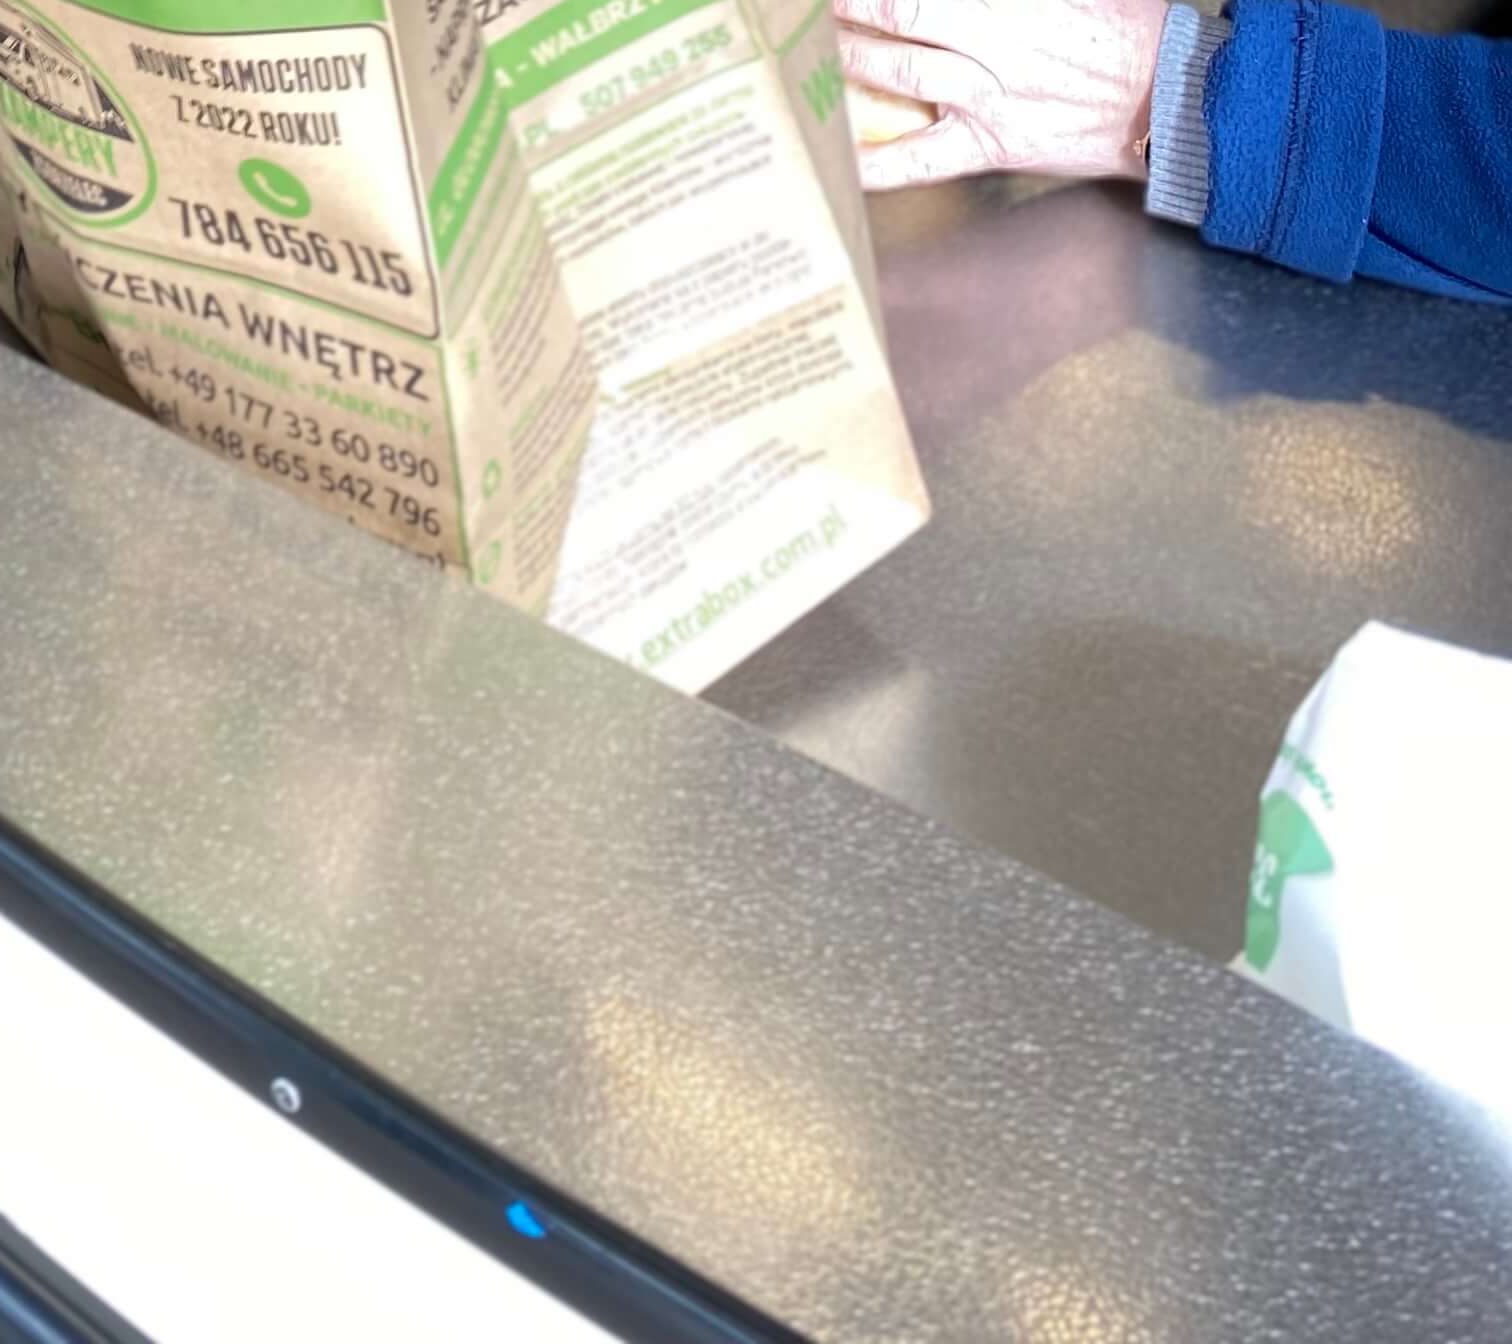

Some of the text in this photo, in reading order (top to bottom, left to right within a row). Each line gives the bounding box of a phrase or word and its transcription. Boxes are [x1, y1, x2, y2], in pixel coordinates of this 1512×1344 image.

[128, 41, 200, 87] NOWE
[202, 51, 369, 95] SAMOCHODY
[190, 98, 257, 140] 2022
[260, 110, 343, 146] ROKU!
[168, 197, 413, 297] 784 656 115
[238, 302, 430, 401] WNĘTRZ
[170, 368, 216, 403] +49
[224, 385, 276, 428] 177
[284, 409, 323, 447] 33
[331, 431, 372, 464] 60
[378, 445, 440, 488] 890
[195, 423, 245, 460] +48
[252, 442, 310, 484] 665
[318, 465, 376, 510] 542
[385, 489, 442, 538] 796
